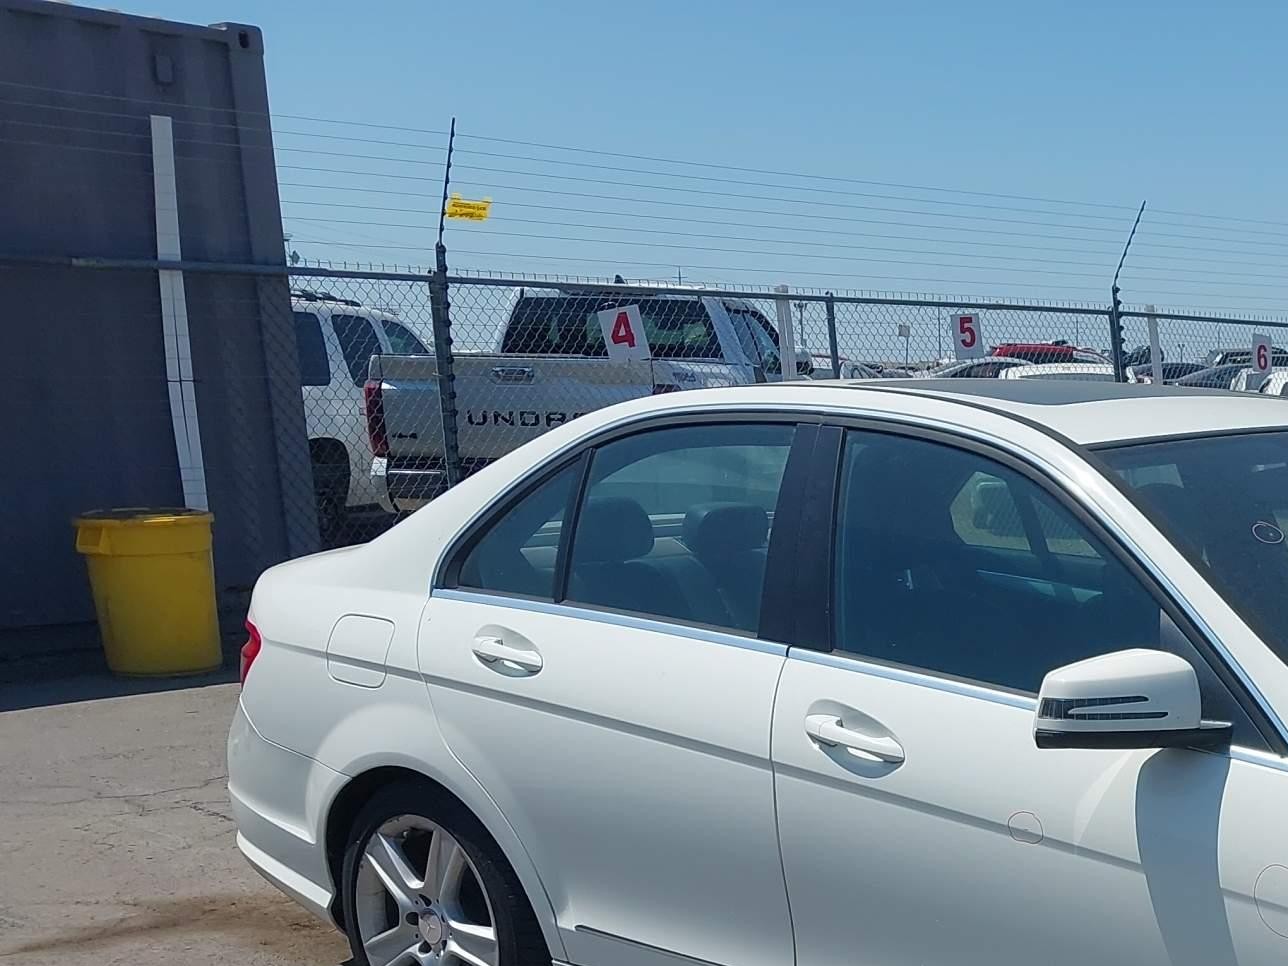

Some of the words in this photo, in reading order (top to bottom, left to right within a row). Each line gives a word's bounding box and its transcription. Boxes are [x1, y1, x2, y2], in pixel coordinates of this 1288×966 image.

[611, 312, 636, 348] 4
[959, 316, 977, 349] 5
[1257, 345, 1269, 371] 6
